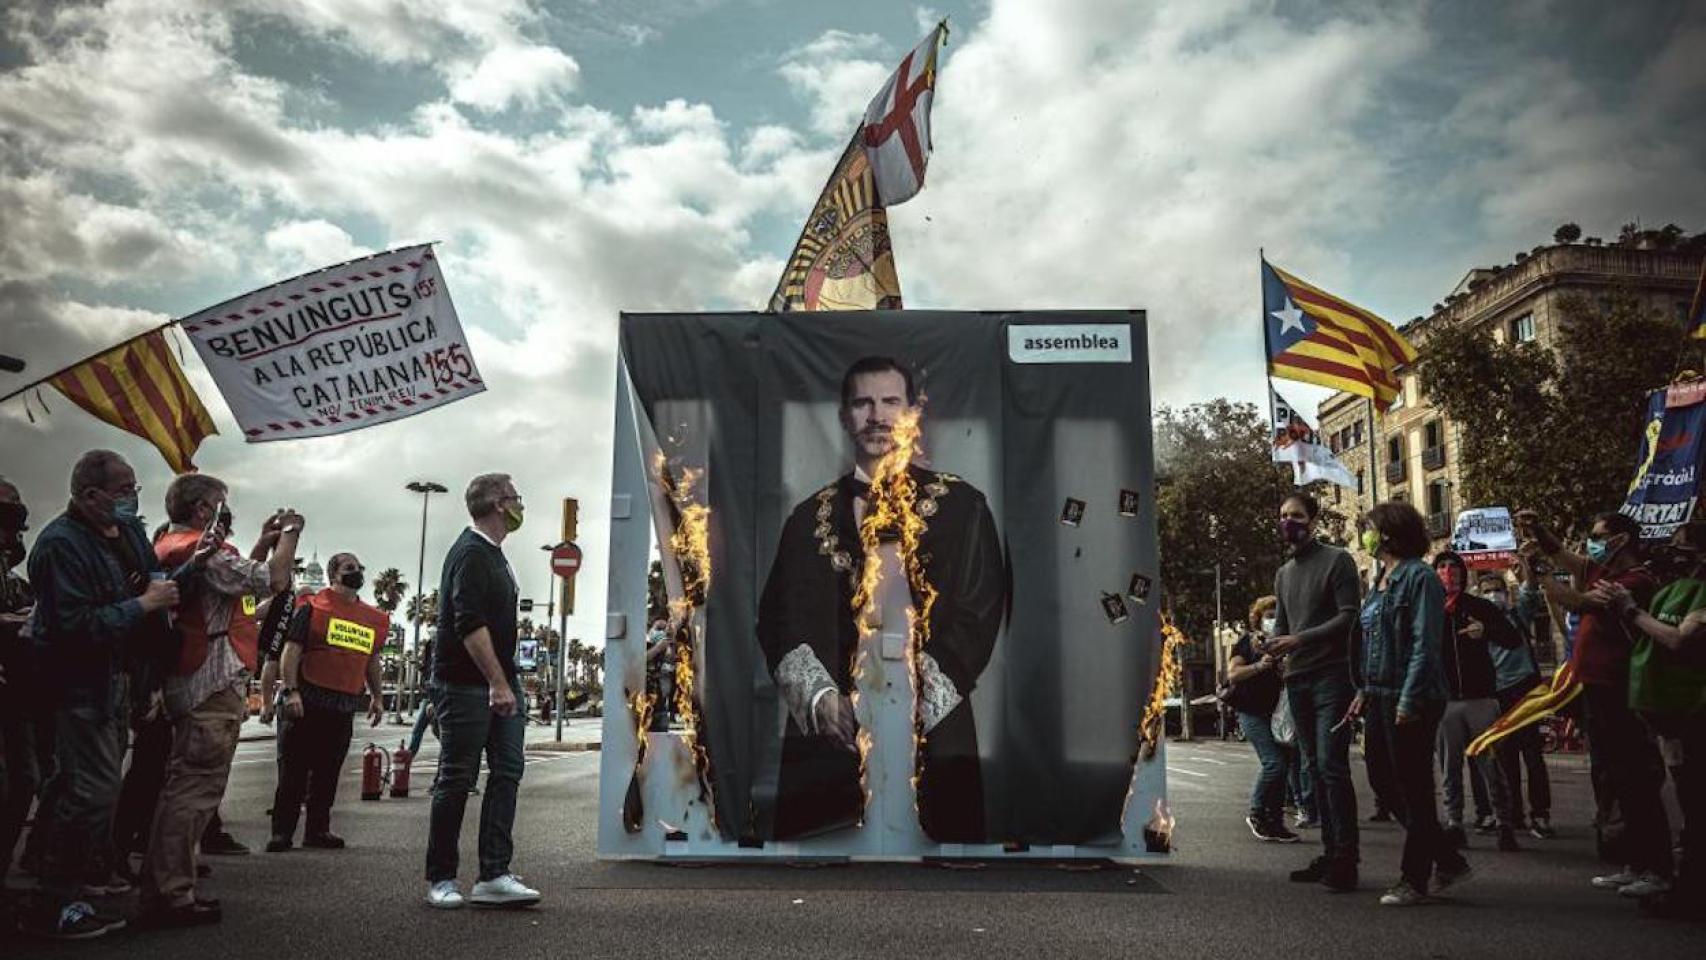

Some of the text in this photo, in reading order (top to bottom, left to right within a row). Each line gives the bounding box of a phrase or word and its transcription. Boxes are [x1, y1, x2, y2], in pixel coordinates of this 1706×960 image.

[207, 282, 412, 357] BENVINGUTS
[253, 315, 438, 385] A LA REPÚBLICA
[1024, 333, 1119, 350] assemblea
[293, 342, 472, 408] CATALANA 155
